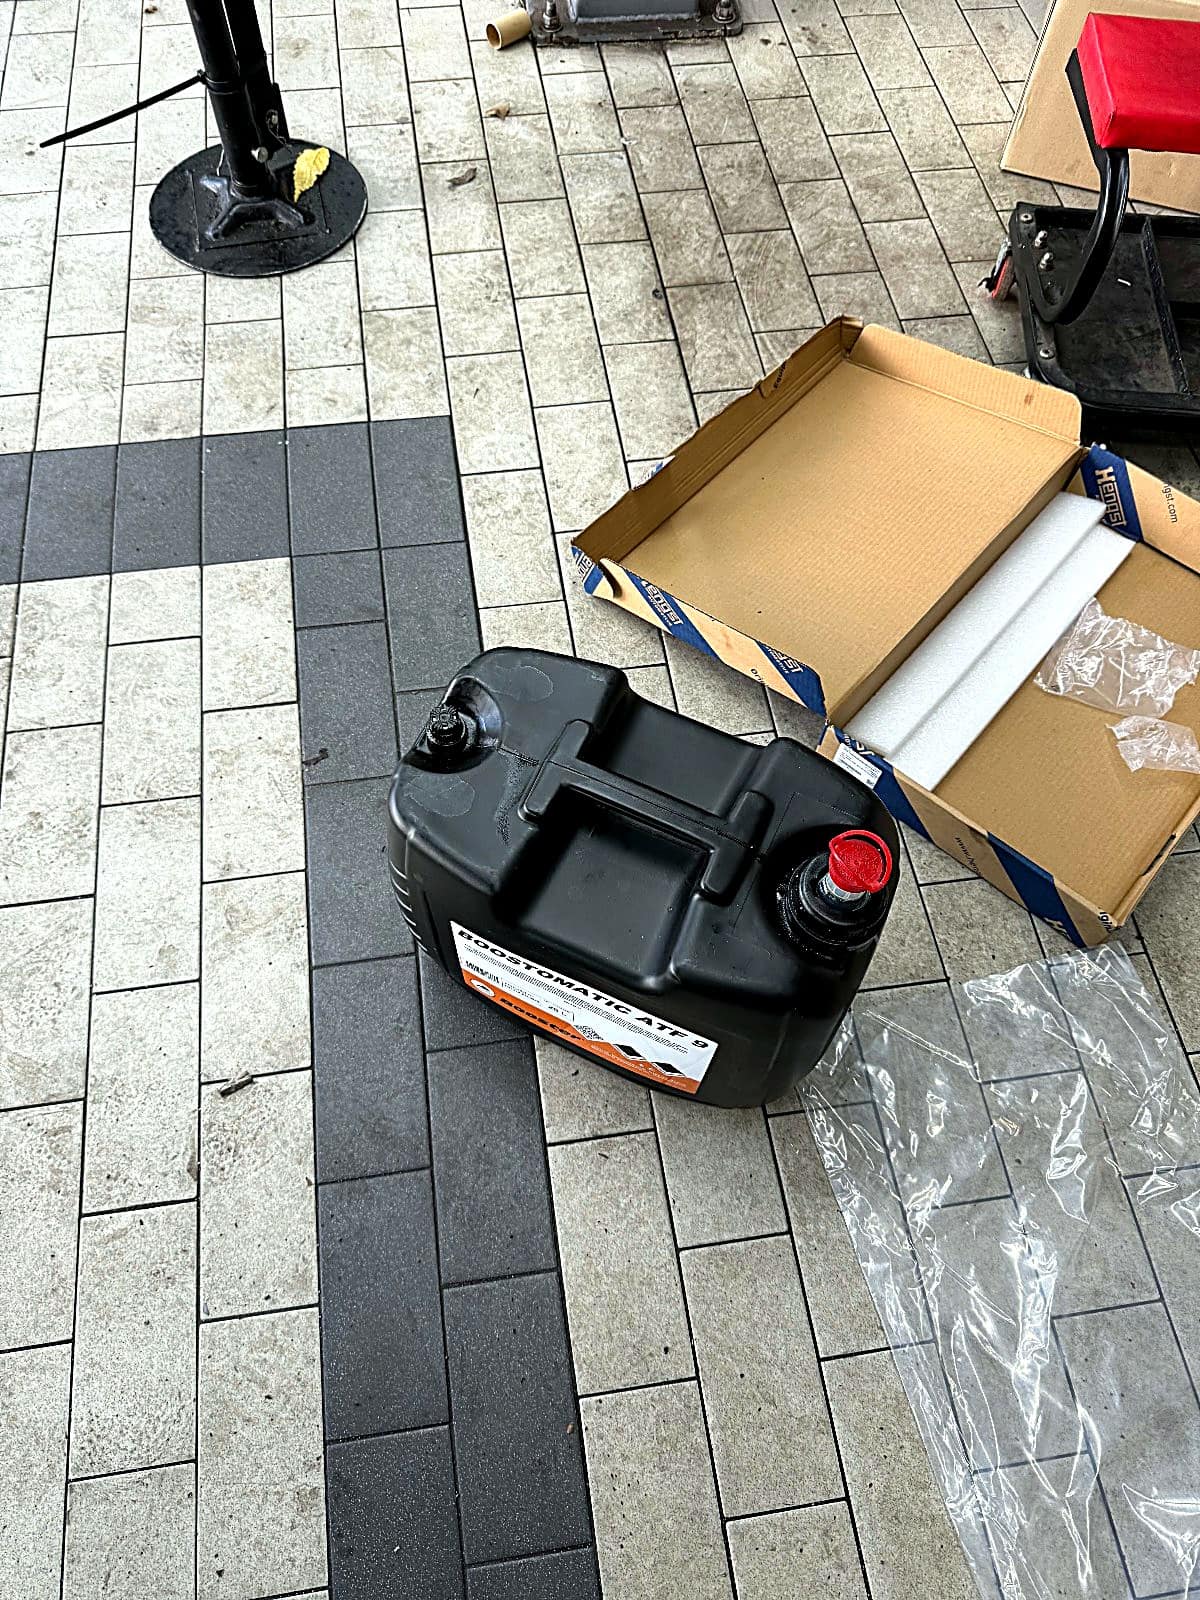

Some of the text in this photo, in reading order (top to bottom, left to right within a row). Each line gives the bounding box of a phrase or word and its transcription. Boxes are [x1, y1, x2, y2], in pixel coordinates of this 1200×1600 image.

[1095, 467, 1127, 526] Hengst
[458, 929, 631, 1015] BOOSTOMATIC
[635, 1016, 689, 1039] ATF
[691, 1039, 708, 1049] 9
[500, 997, 583, 1041] Booster
